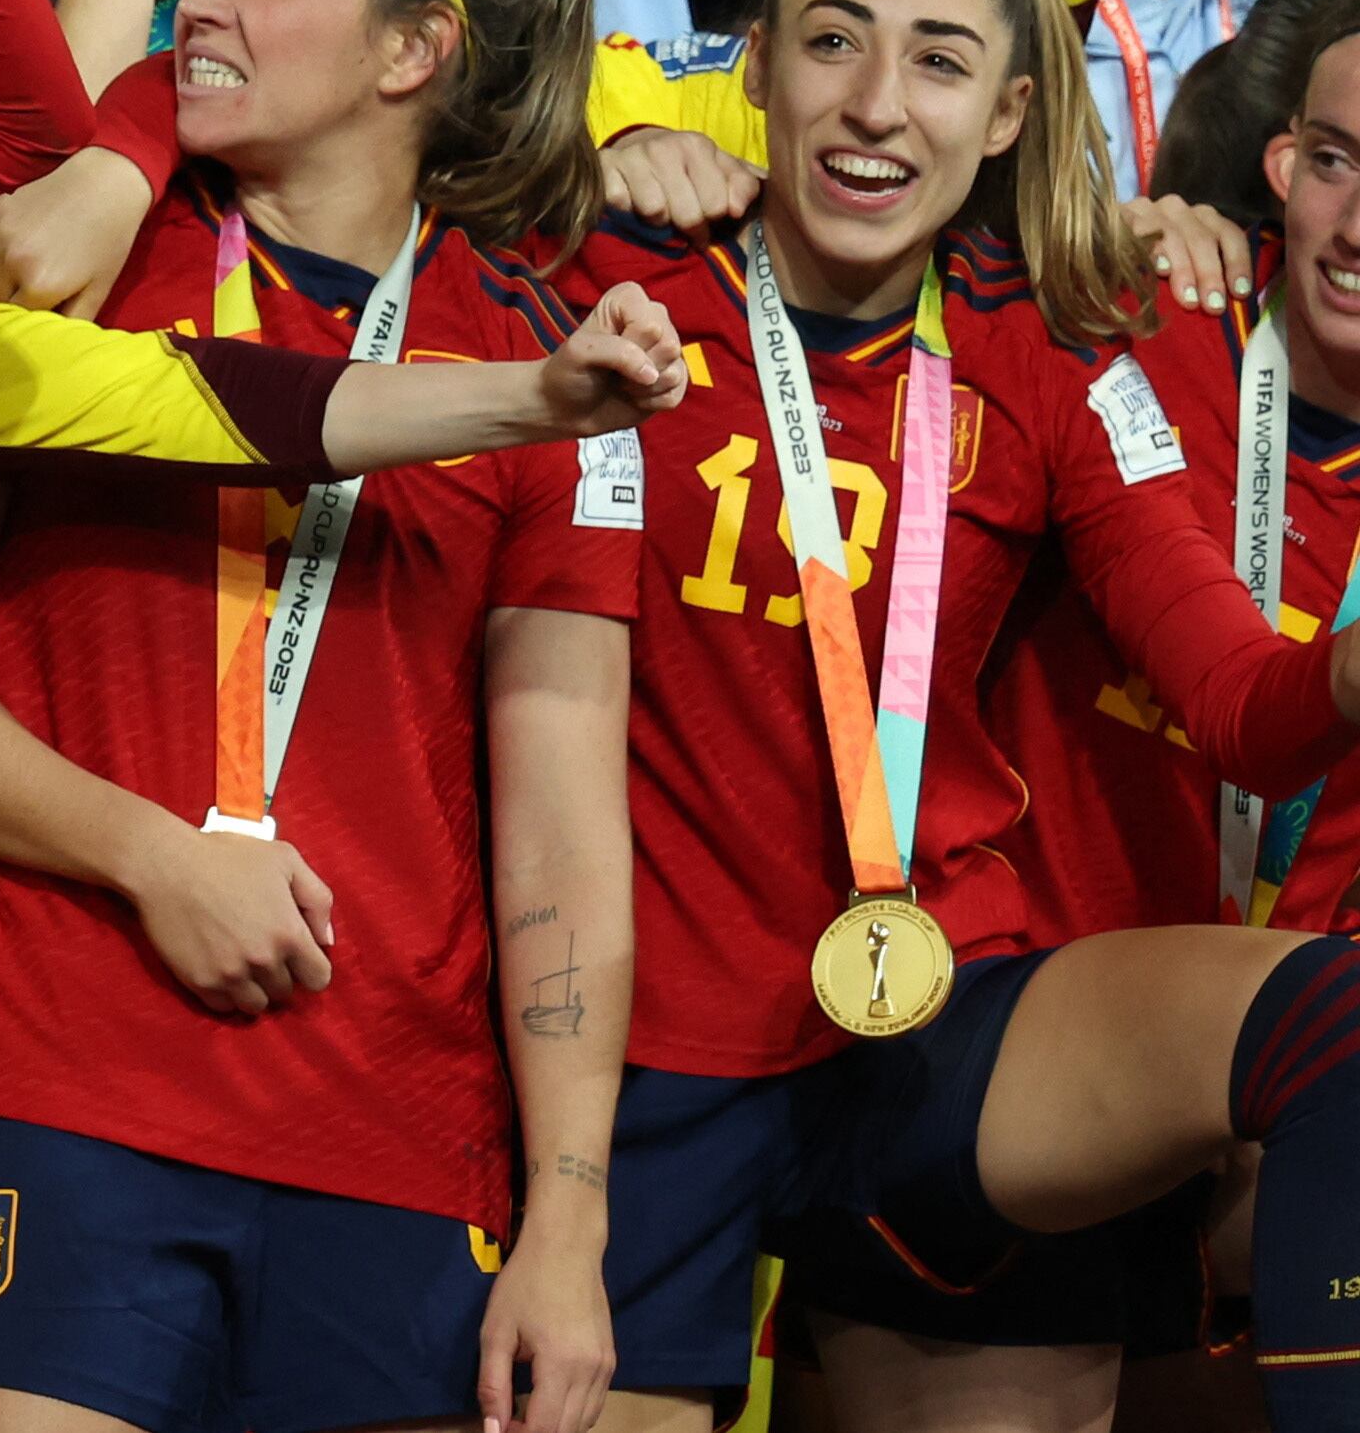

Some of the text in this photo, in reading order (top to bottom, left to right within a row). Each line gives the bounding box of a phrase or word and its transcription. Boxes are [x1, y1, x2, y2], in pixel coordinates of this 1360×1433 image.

[373, 299, 398, 341] FIFA
[759, 282, 780, 325] CUP
[1256, 368, 1274, 416] FIFA
[1252, 418, 1272, 528] WOMEN'S
[312, 514, 333, 555] CUP
